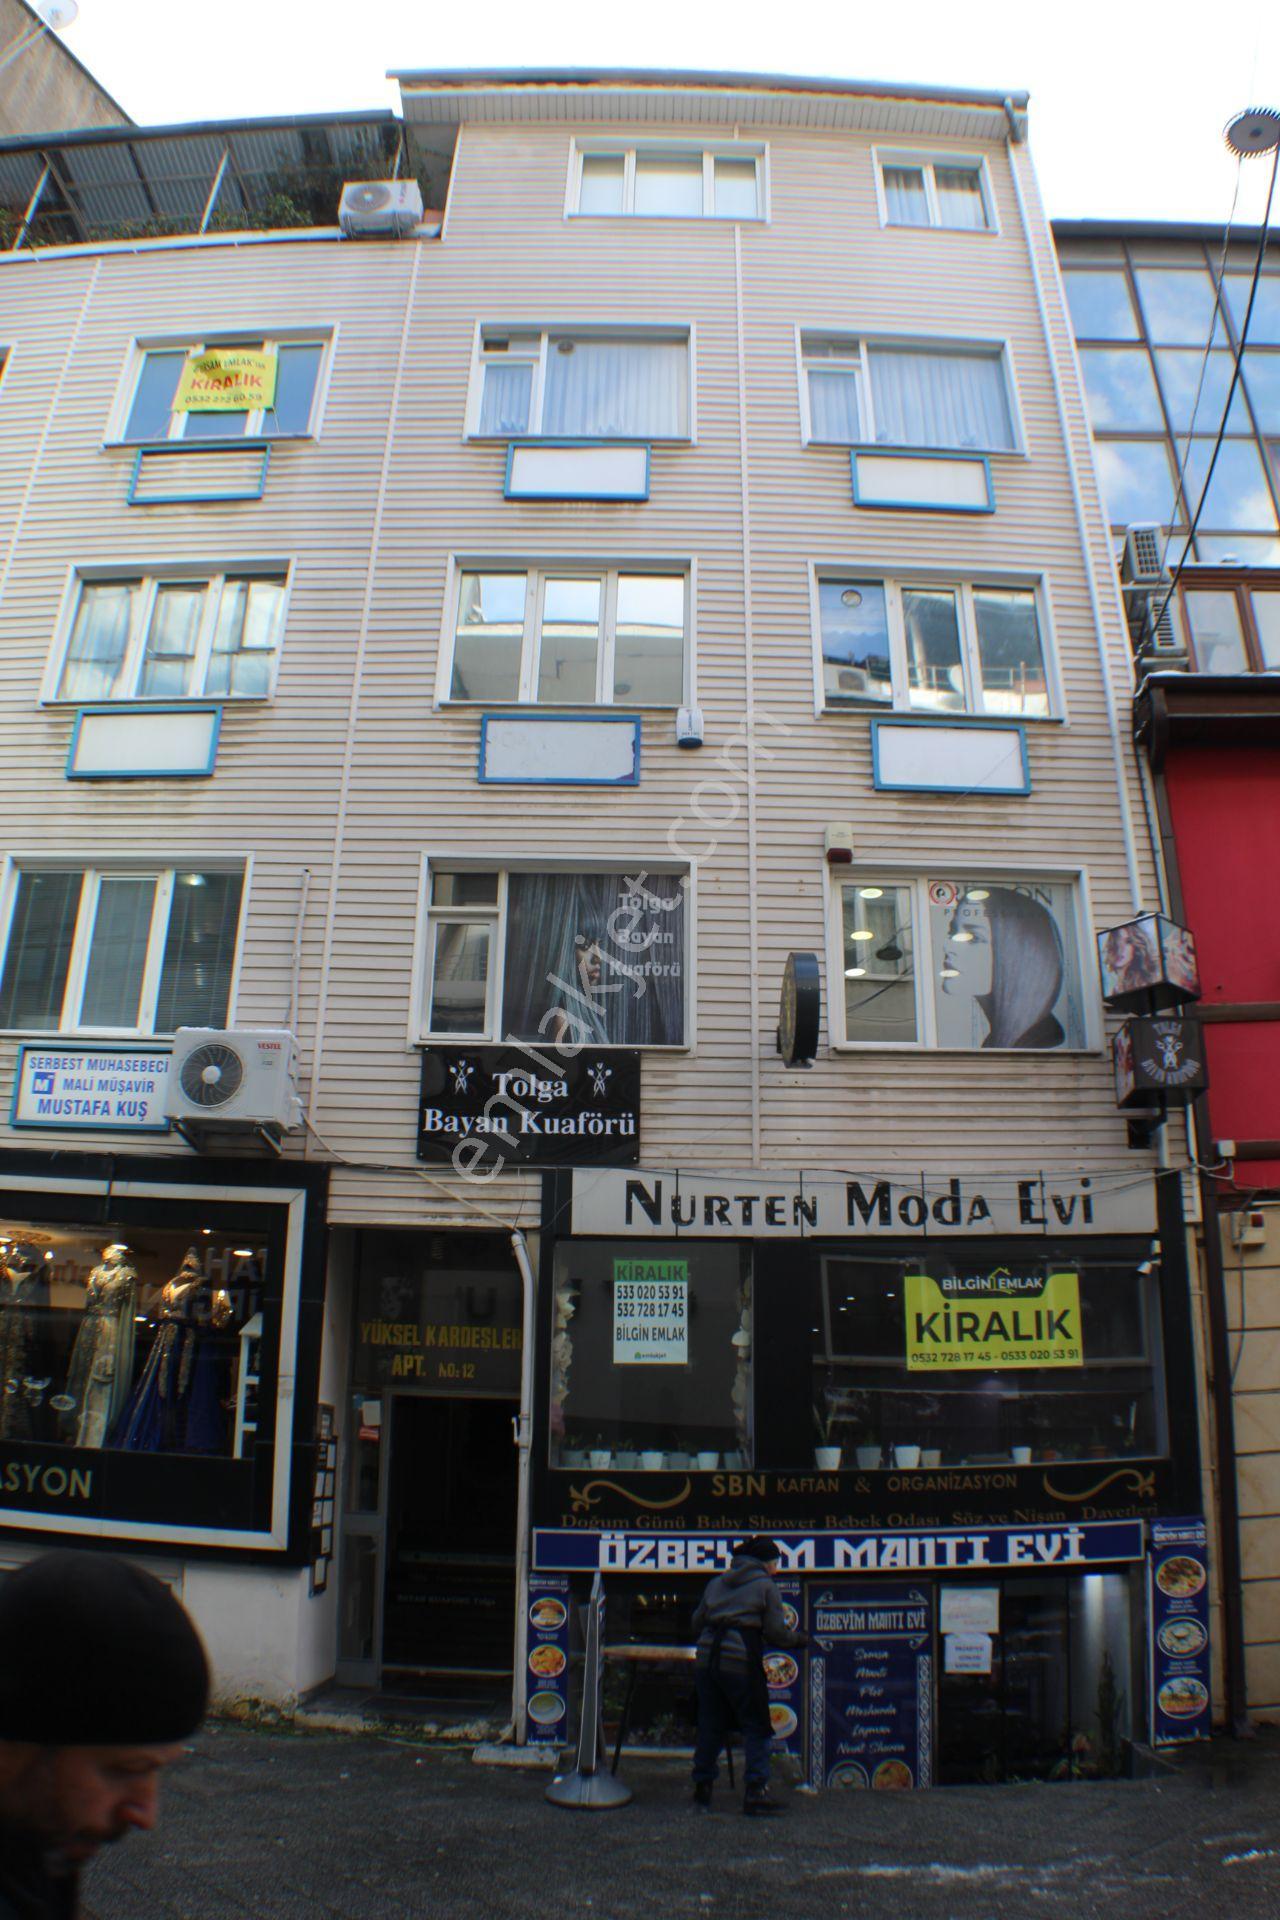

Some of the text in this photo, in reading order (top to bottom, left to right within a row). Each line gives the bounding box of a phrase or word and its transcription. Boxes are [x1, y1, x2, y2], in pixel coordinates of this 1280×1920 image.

[29, 1057, 169, 1073] SERBEST MUHASEBECİ
[63, 1076, 155, 1096] MALİ MÜŞAVİR
[492, 1073, 569, 1103] Tolga
[37, 1098, 148, 1122] MUSTAFA KUŞ
[424, 1108, 636, 1138] Bayan Kuaförü
[617, 1262, 684, 1281] KİRALIK
[617, 1285, 684, 1300] 533 020 53 91
[942, 1276, 1043, 1291] BİLGİN EMLAK
[617, 1303, 684, 1318] 532 728 17 45
[361, 1320, 421, 1346] YÜKSEL
[616, 1323, 685, 1342] BİLGİN EMLAK
[915, 1302, 1073, 1344] KİRALIK
[391, 1354, 426, 1377] APT.
[911, 1352, 938, 1363] 0532
[941, 1352, 961, 1362] 728
[964, 1352, 975, 1361] 17
[978, 1351, 991, 1361] 45
[1001, 1350, 1027, 1361] 0533
[1029, 1350, 1050, 1360] 020
[1053, 1350, 1065, 1359] 53
[1067, 1349, 1079, 1359] 91
[712, 1472, 1018, 1497] SBN KAFTAN & ORGANİZASYON
[561, 1514, 629, 1532] Doğum
[635, 1514, 686, 1530] Günü
[697, 1515, 743, 1530] Baby
[748, 1515, 816, 1530] Shower
[824, 1513, 881, 1529] Bebek
[599, 1533, 815, 1569] ÖZBEYM
[1007, 1526, 1086, 1563] EVİ
[816, 1609, 865, 1631] ÖZBEYİM
[907, 1607, 926, 1629] EVİ
